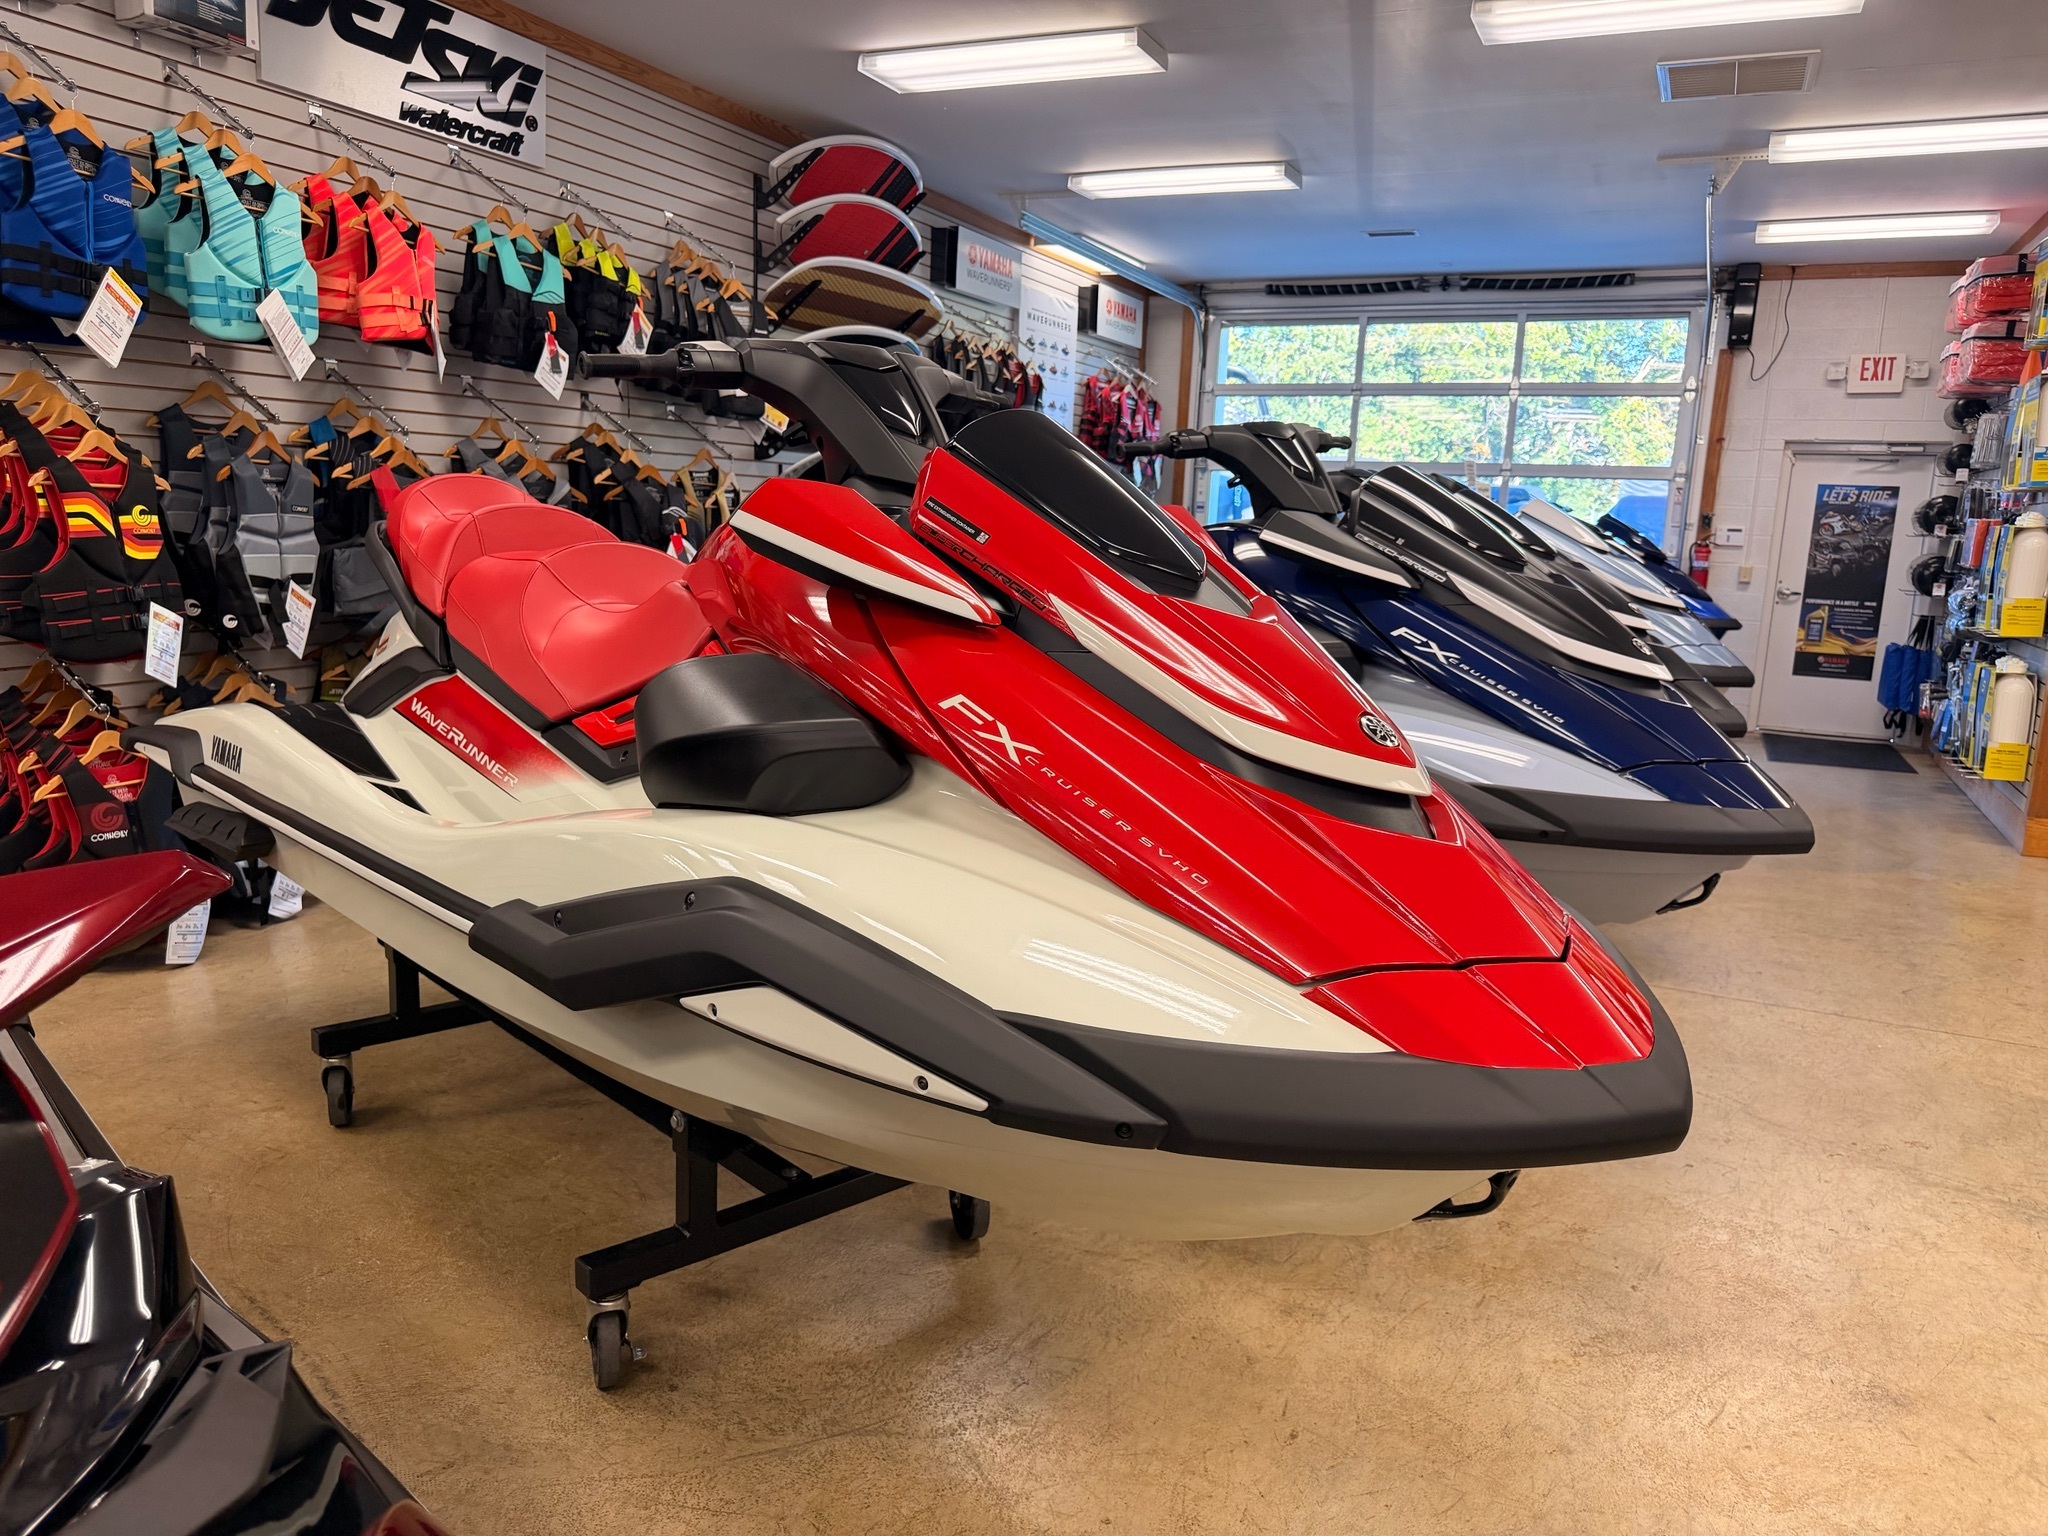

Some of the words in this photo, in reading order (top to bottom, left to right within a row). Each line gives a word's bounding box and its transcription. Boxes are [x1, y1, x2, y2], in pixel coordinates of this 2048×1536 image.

[399, 101, 525, 156] watercraft
[978, 246, 1013, 280] YAMAHA
[1113, 300, 1137, 325] YAMAHA
[1859, 356, 1897, 381] EXIT
[1822, 488, 1859, 502] LET'S
[1859, 490, 1892, 503] RIDE
[919, 523, 1048, 612] SUPERCHARGED
[1390, 626, 1461, 665] FX
[1448, 658, 1519, 698] CRUISER
[1521, 698, 1566, 724] SVHO
[211, 734, 243, 774] YAMAHA
[411, 696, 519, 788] WAVERUNNER
[938, 693, 1045, 766] FX
[1024, 755, 1133, 832] CRUISER
[1138, 836, 1209, 886] SVHO
